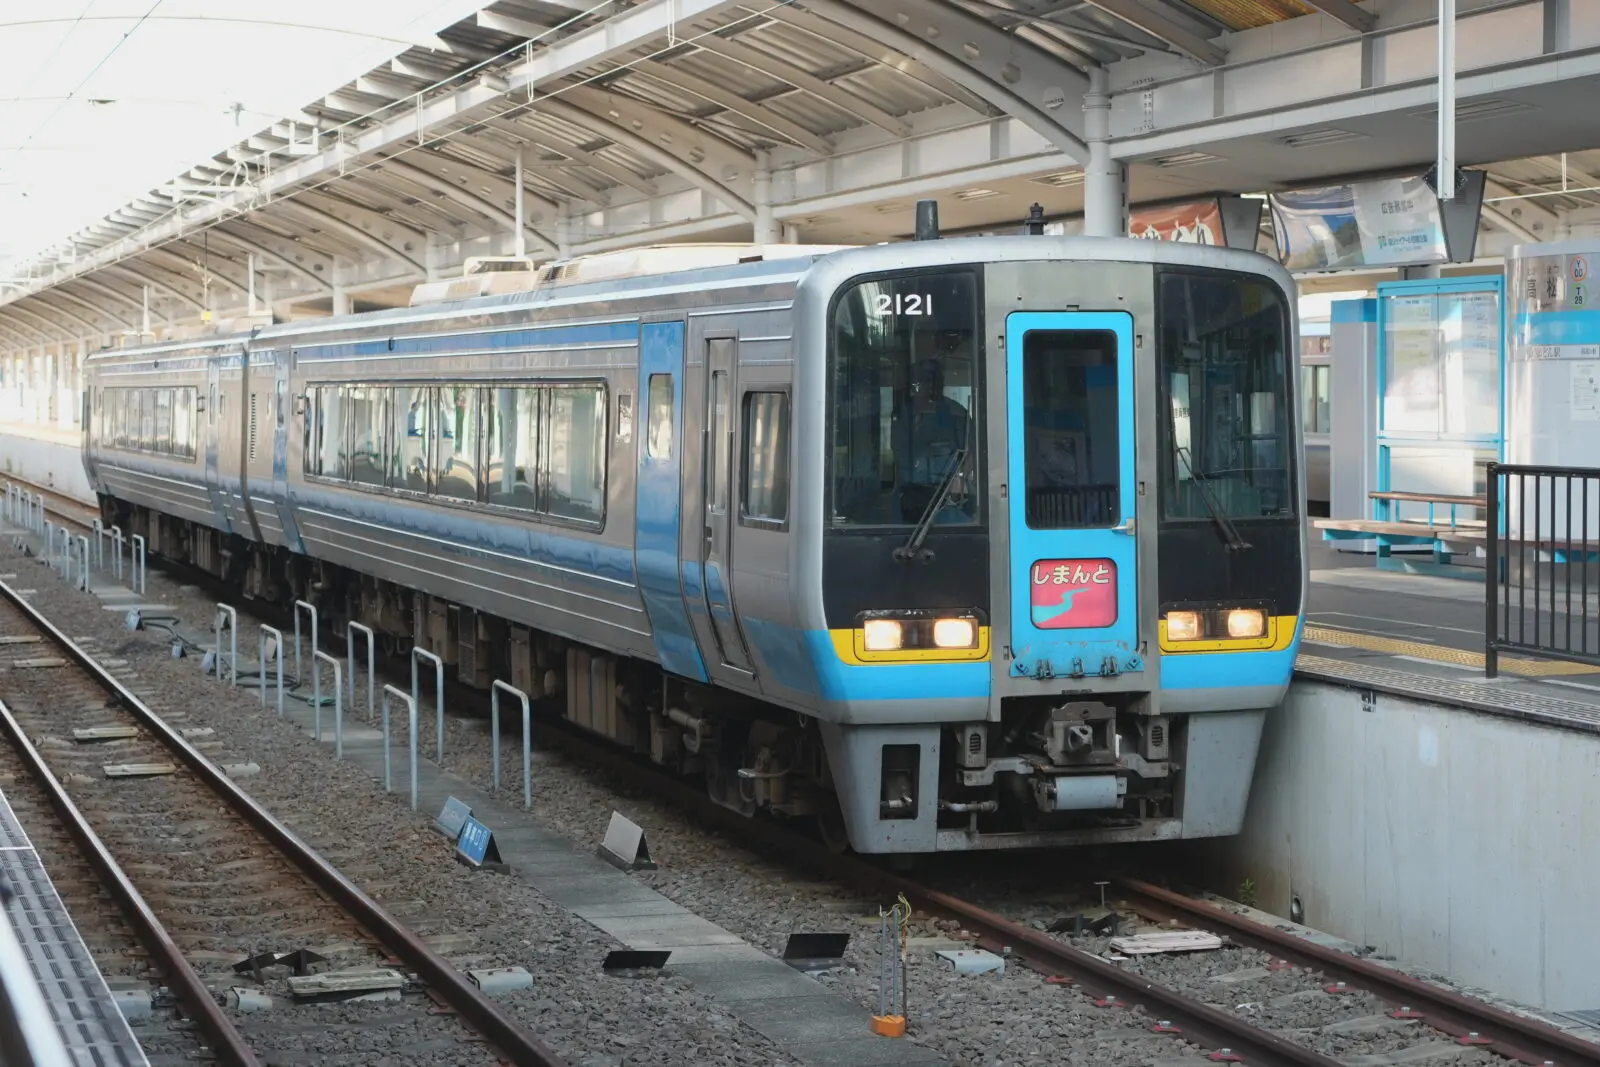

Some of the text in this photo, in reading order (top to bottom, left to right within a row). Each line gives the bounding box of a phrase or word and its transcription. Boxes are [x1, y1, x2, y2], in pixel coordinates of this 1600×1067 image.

[875, 294, 932, 315] 2121
[1574, 296, 1582, 304] 28
[1033, 564, 1109, 585] しまんと
